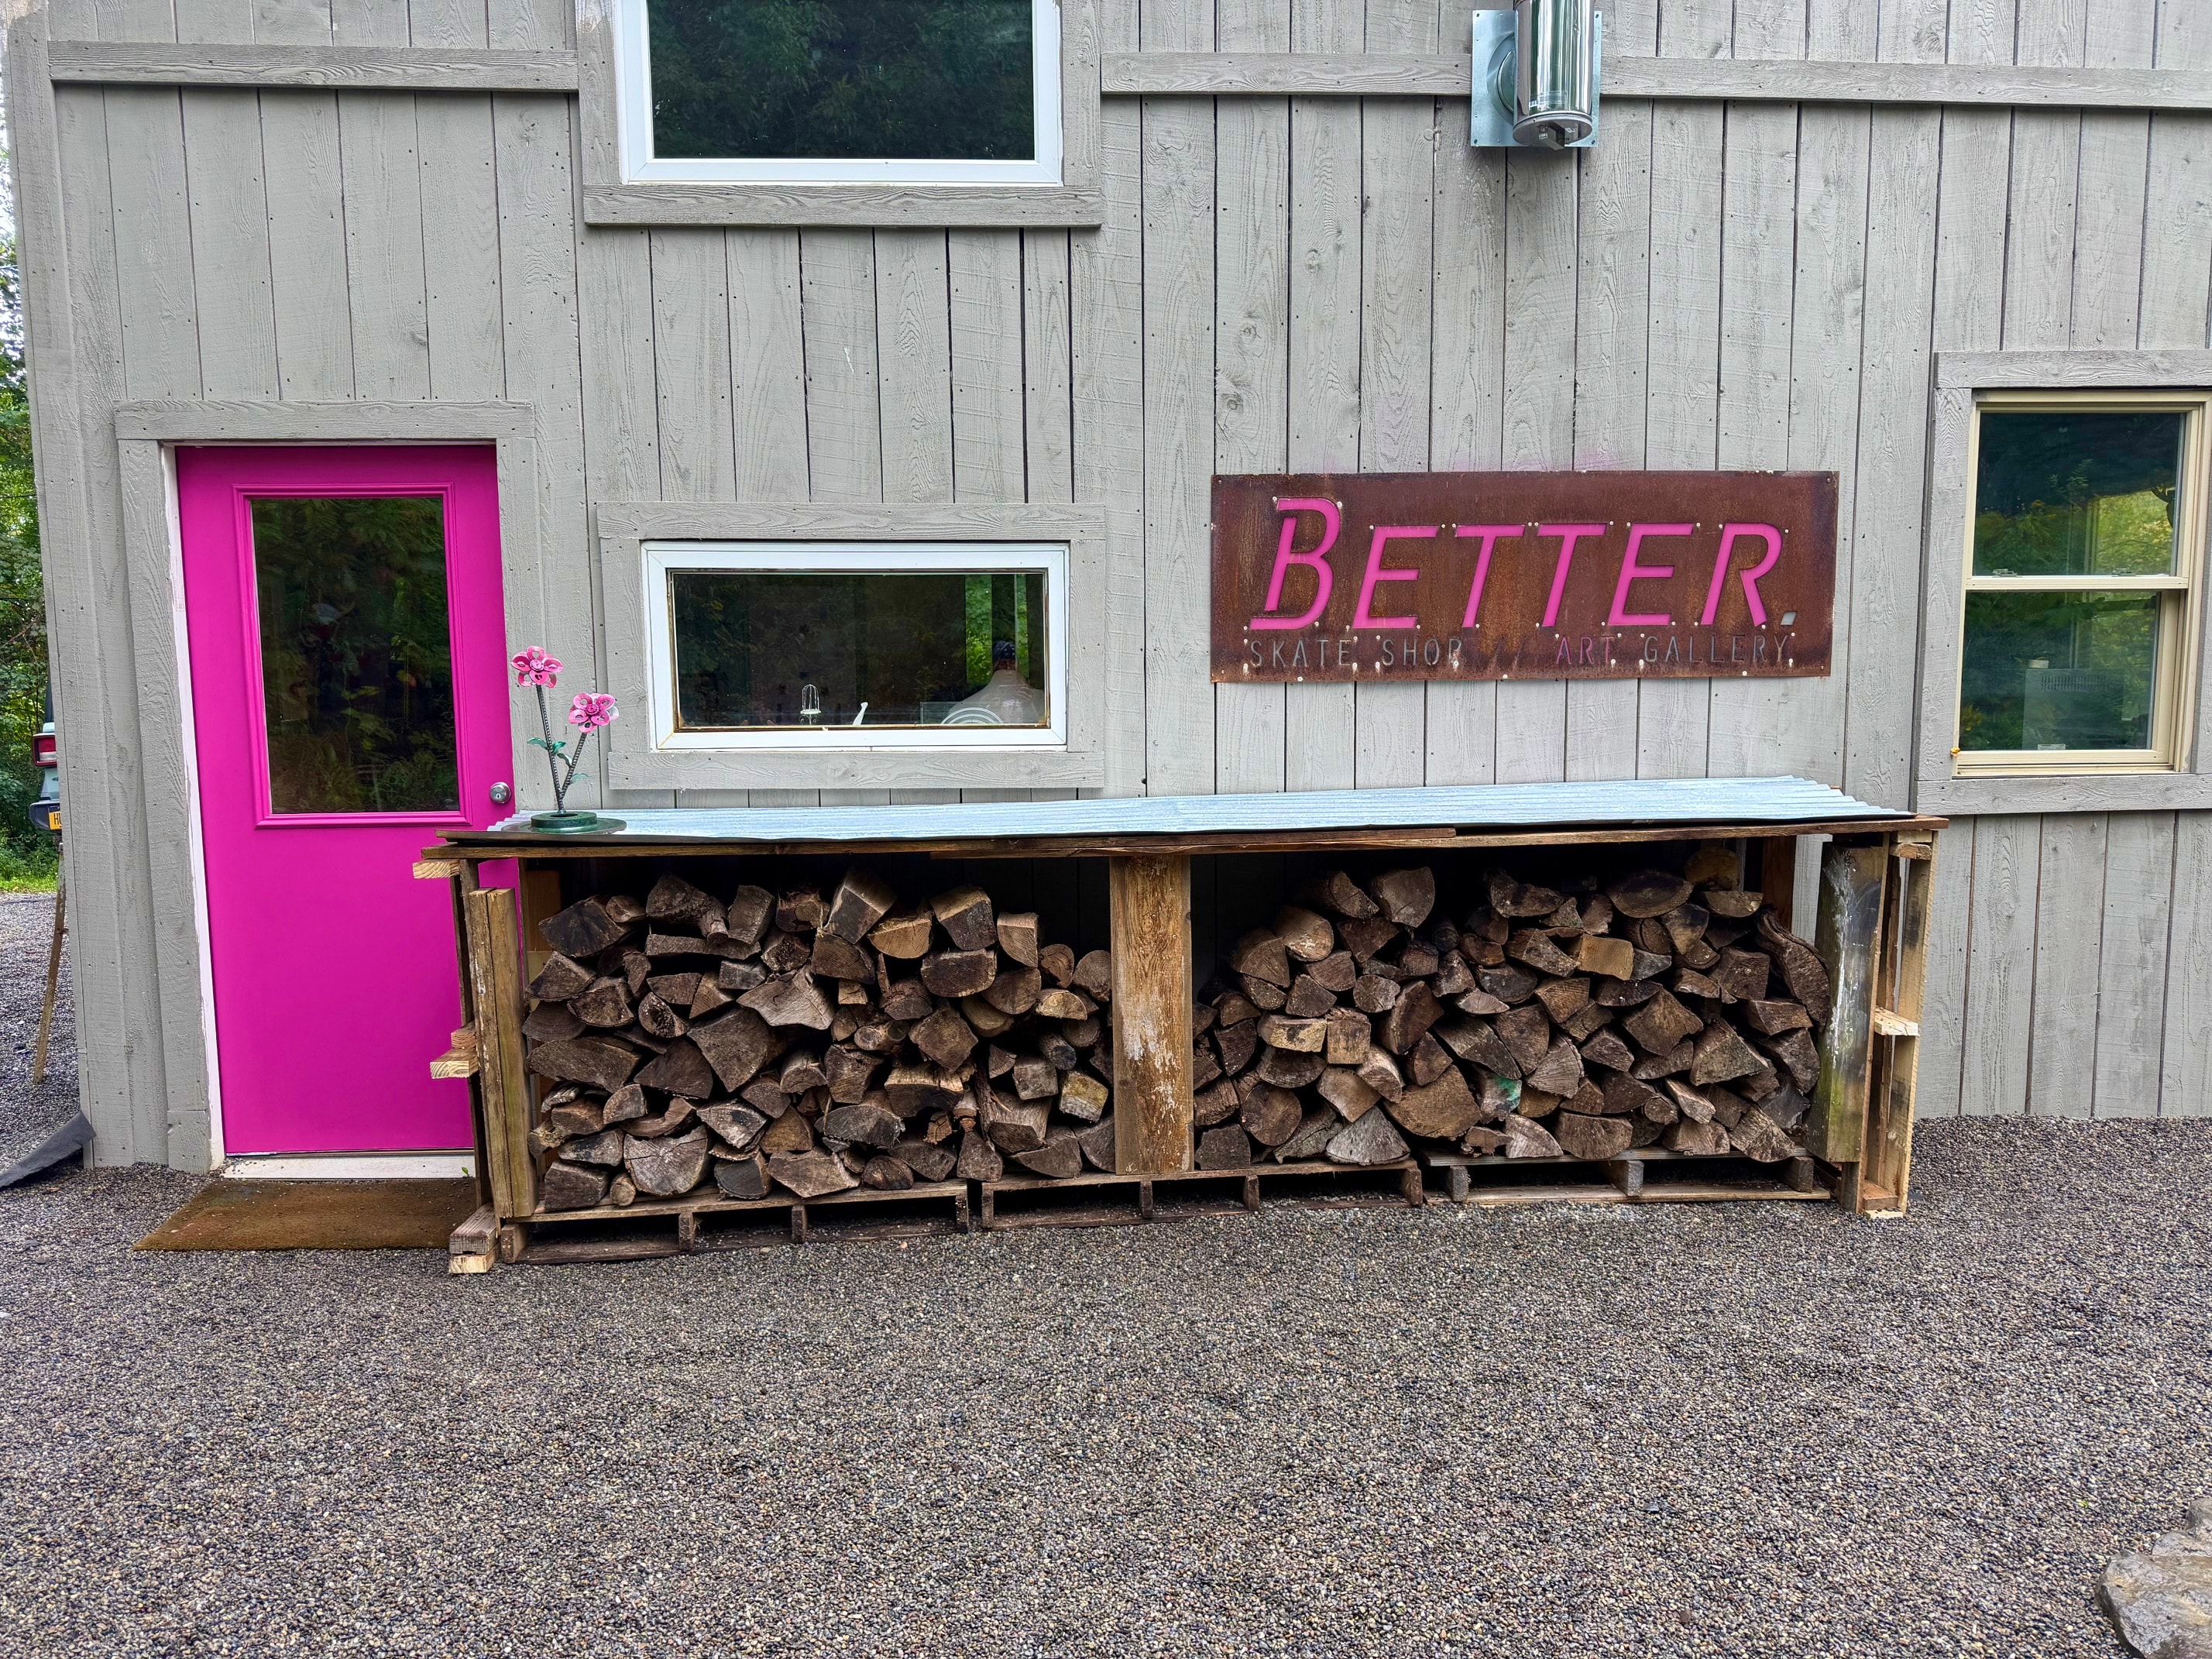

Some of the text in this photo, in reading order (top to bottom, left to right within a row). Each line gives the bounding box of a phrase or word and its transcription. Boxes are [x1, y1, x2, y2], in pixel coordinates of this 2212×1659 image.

[1249, 638, 1352, 667] SKATE
[1381, 637, 1462, 666] SHOP
[1555, 635, 1615, 665] ART
[1644, 634, 1789, 663] GALLERY
